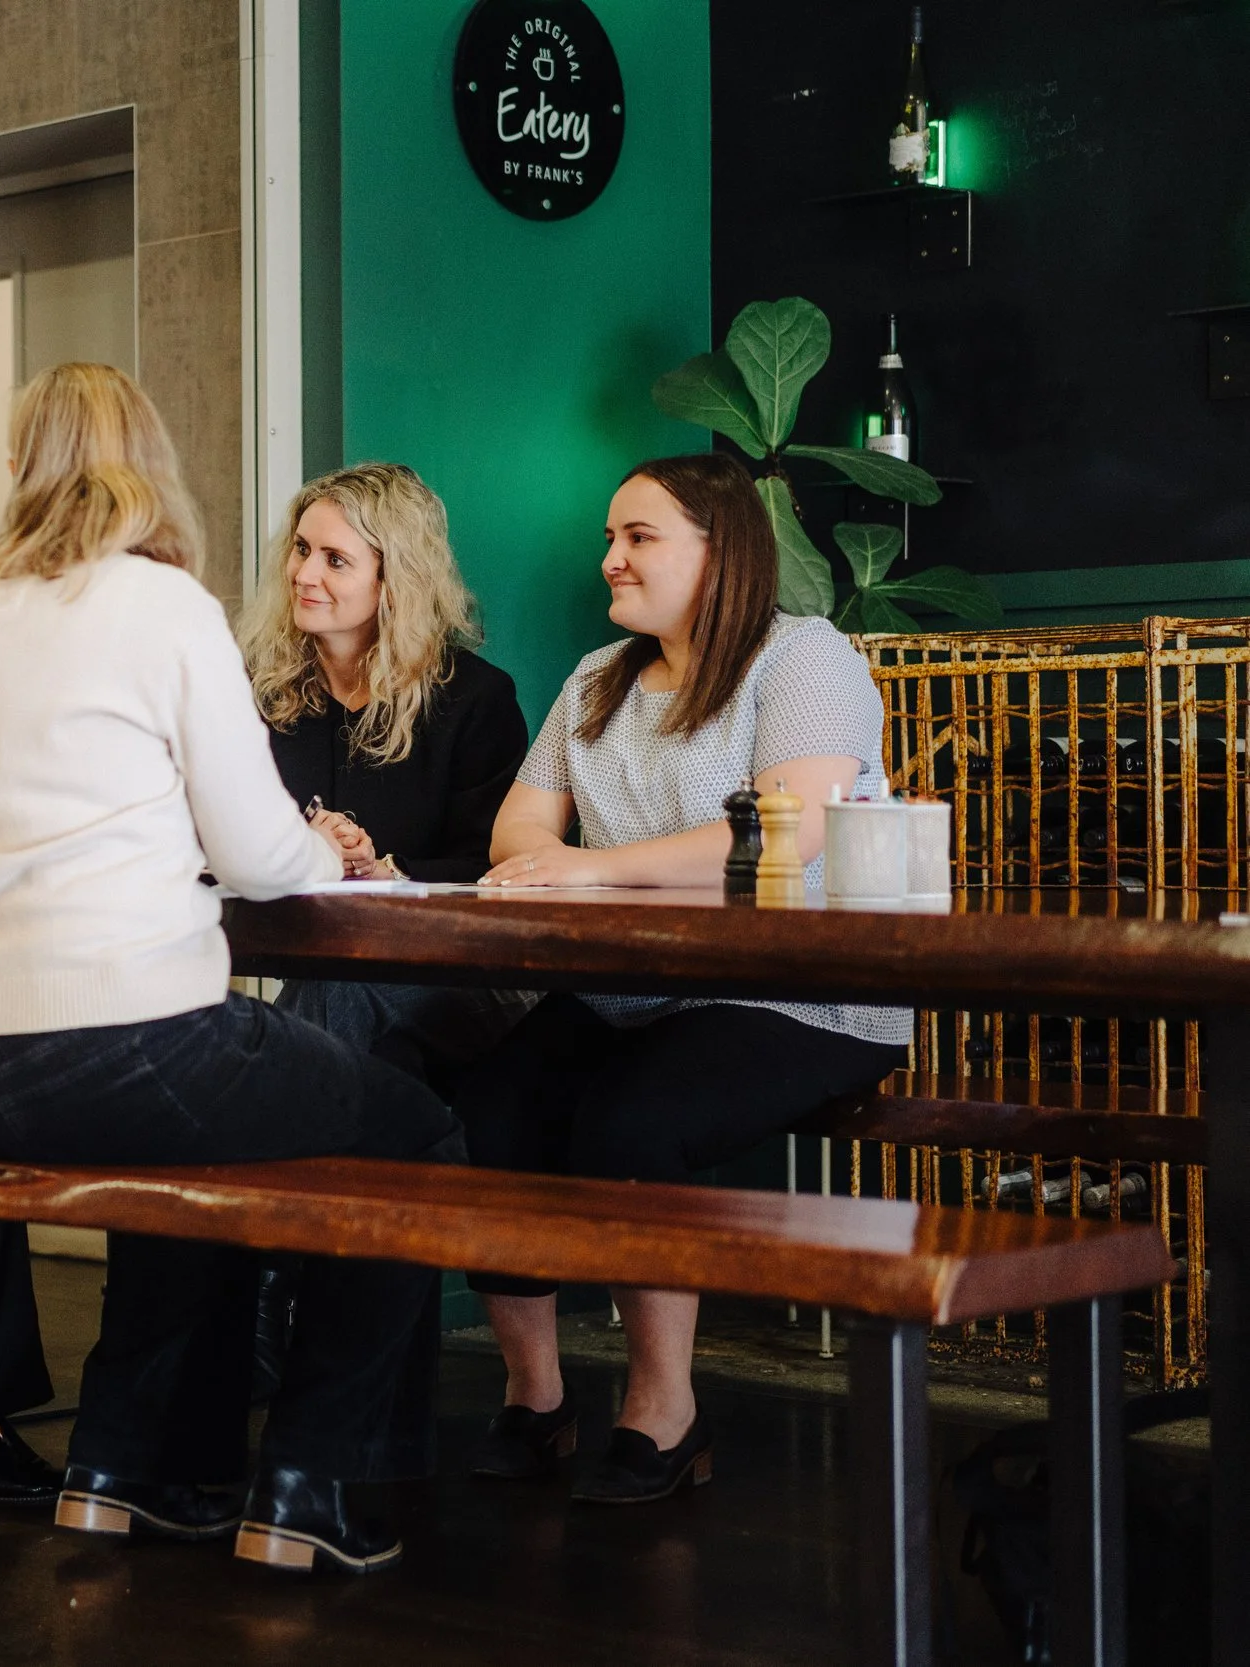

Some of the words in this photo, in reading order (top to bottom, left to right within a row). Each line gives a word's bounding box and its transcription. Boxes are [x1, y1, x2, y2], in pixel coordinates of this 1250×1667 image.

[505, 34, 523, 71] THE
[524, 18, 581, 83] ORIGINAL
[497, 86, 590, 160] Eatery
[504, 160, 520, 176] BY
[527, 164, 584, 186] FRANK'S
